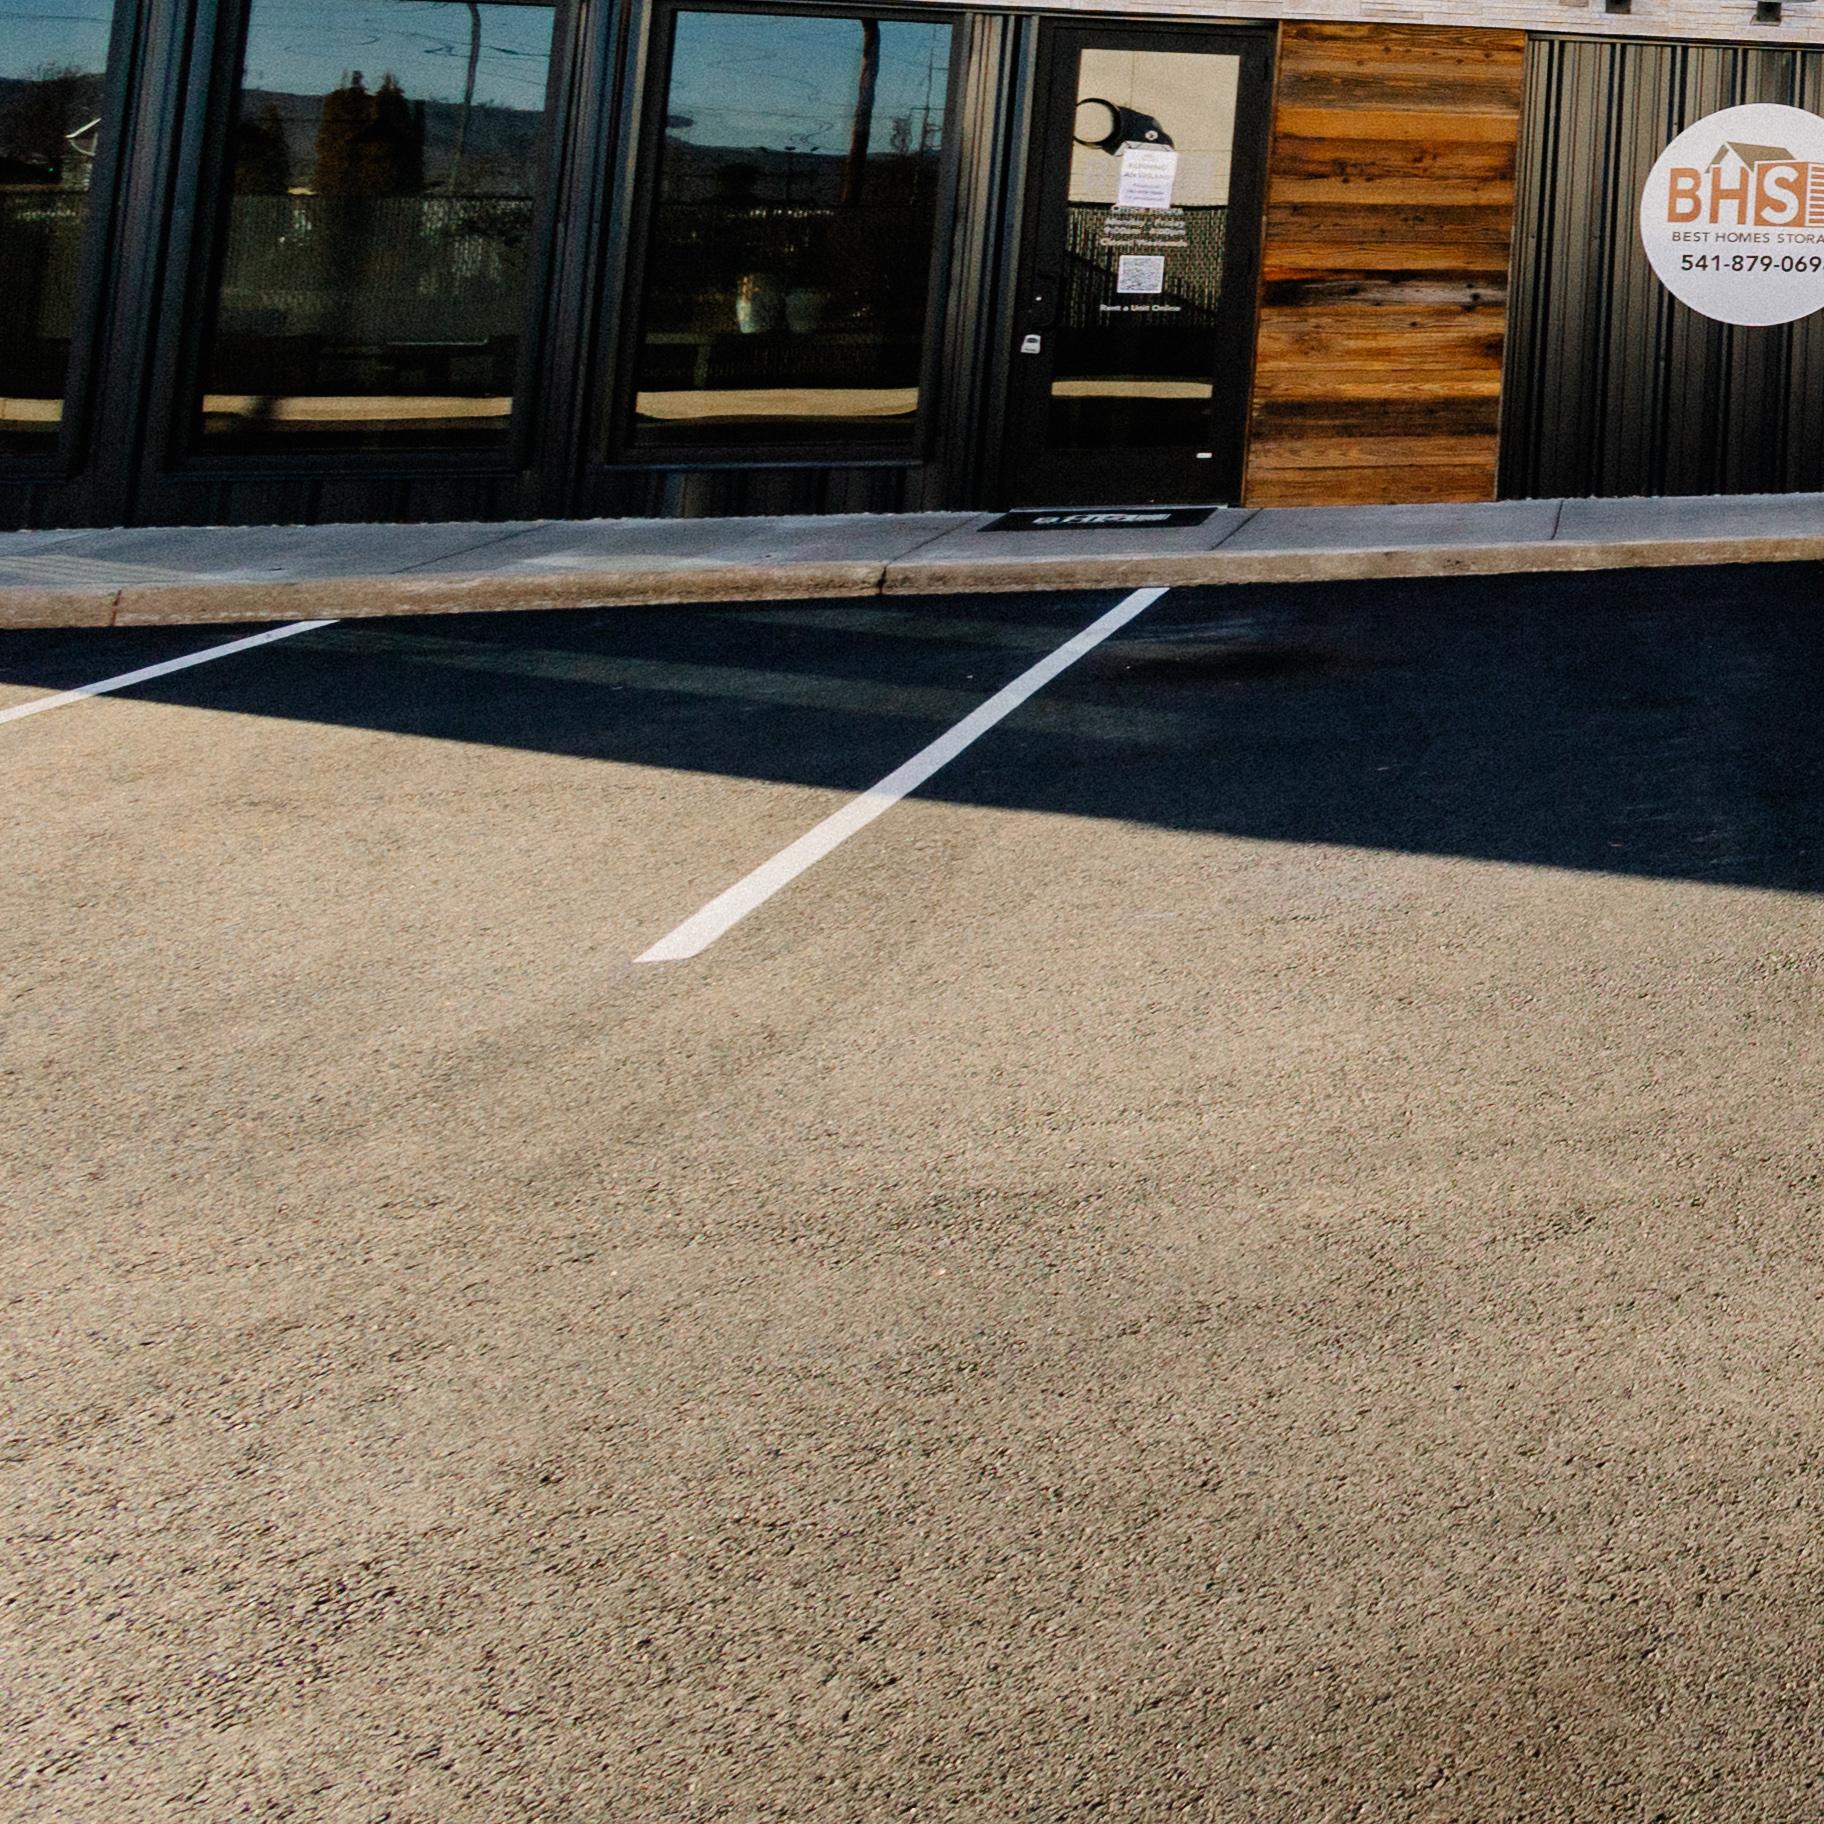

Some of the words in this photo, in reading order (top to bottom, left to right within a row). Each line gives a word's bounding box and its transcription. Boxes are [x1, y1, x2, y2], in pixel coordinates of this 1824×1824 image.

[1667, 165, 1804, 226] BHS
[1672, 231, 1710, 243] BEST
[1715, 232, 1770, 244] HOMES
